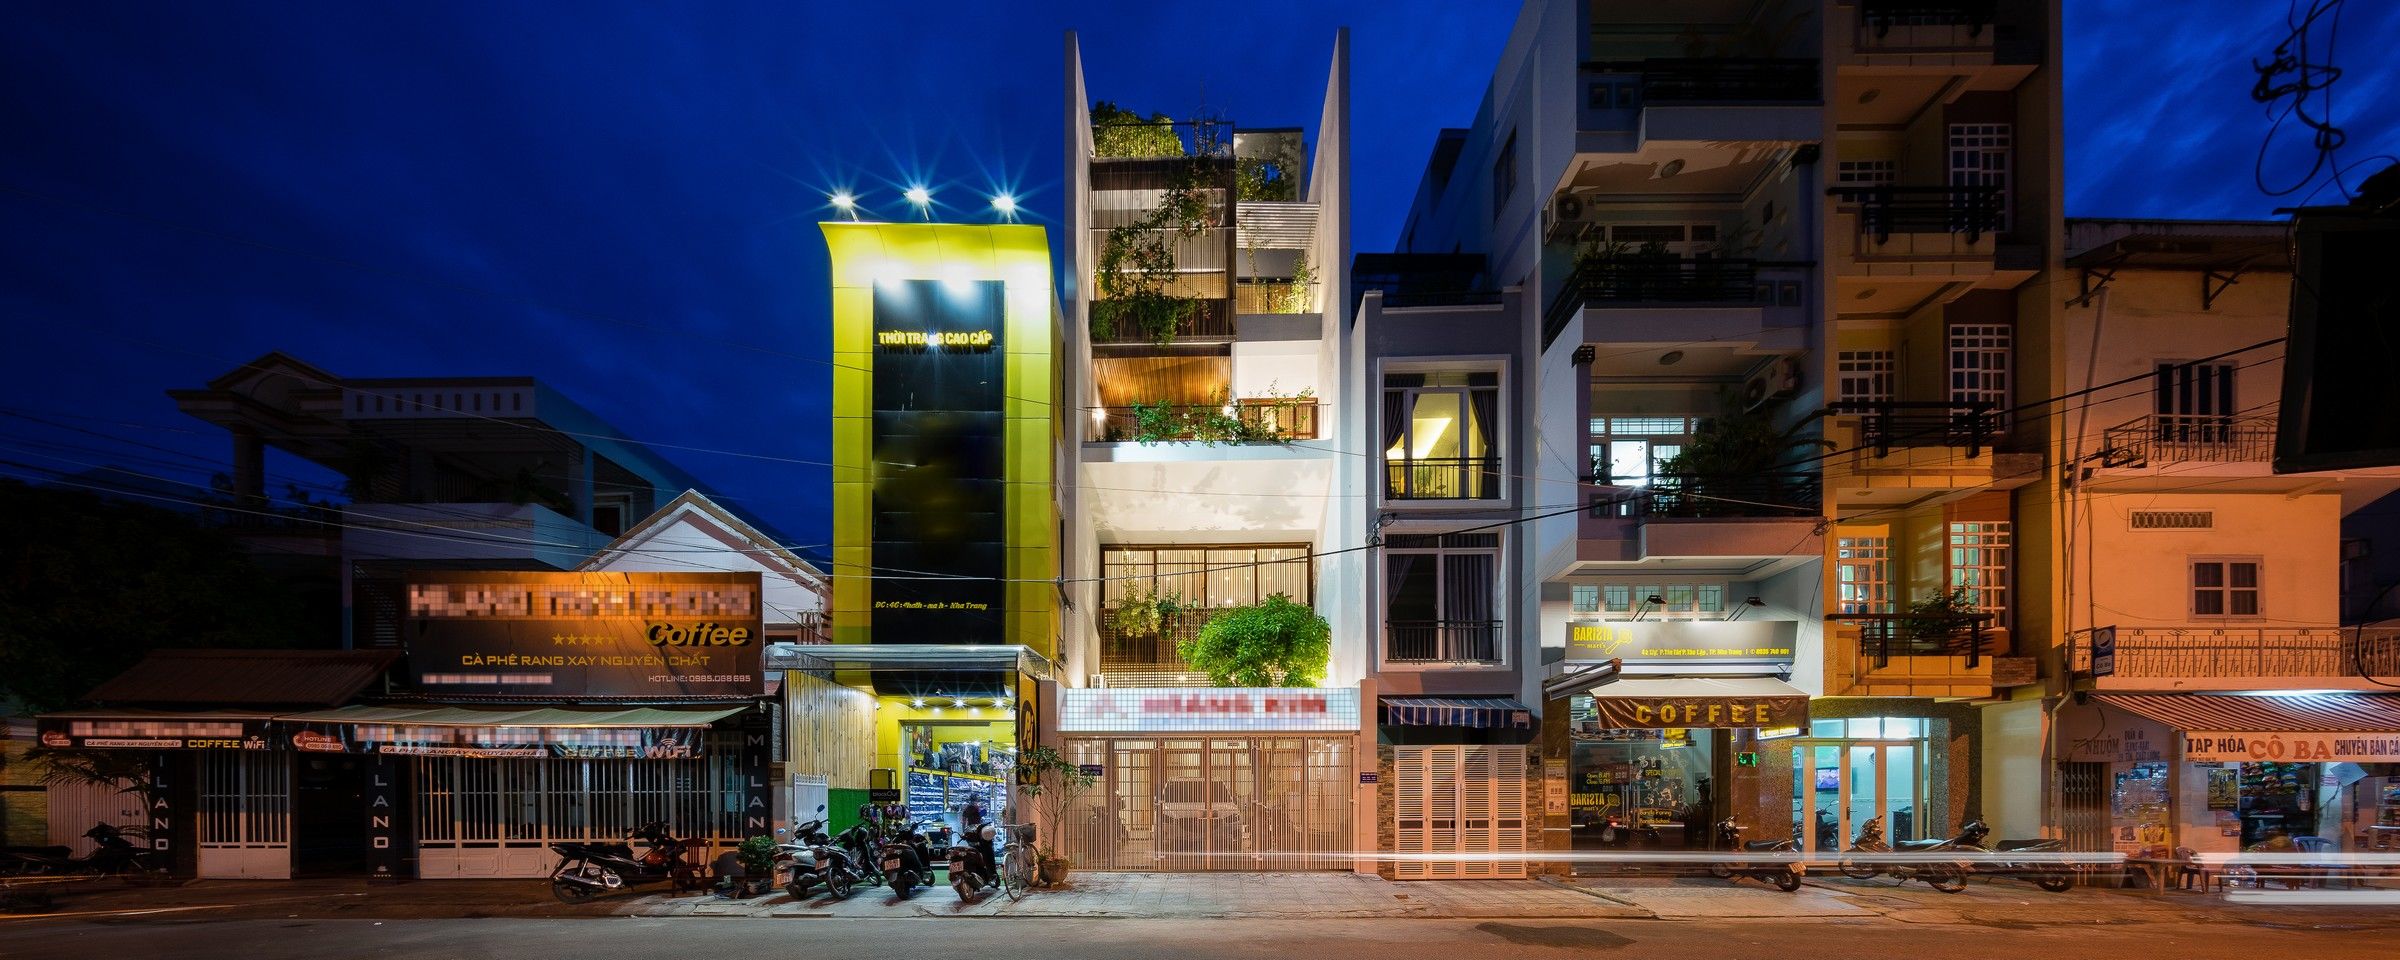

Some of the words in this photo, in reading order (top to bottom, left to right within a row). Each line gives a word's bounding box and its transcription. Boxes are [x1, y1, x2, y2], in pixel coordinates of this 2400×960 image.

[906, 332, 944, 345] TRAG
[945, 332, 969, 345] CAO
[970, 330, 993, 345] CẤP
[644, 622, 748, 647] Coffee
[462, 653, 484, 666] CÀ
[487, 654, 518, 666] PHÊ
[521, 656, 564, 666] RANG
[567, 656, 597, 667] XAY
[600, 653, 664, 667] NGUYÊN
[668, 650, 711, 667] CHẤT
[1636, 704, 1770, 723] COFFEE
[188, 740, 240, 749] COFFEE
[2187, 738, 2213, 756] TẠP
[2217, 735, 2247, 753] HÓA
[2250, 734, 2285, 760] CÔ
[2293, 740, 2332, 760] BA
[2370, 736, 2387, 756] BÁN
